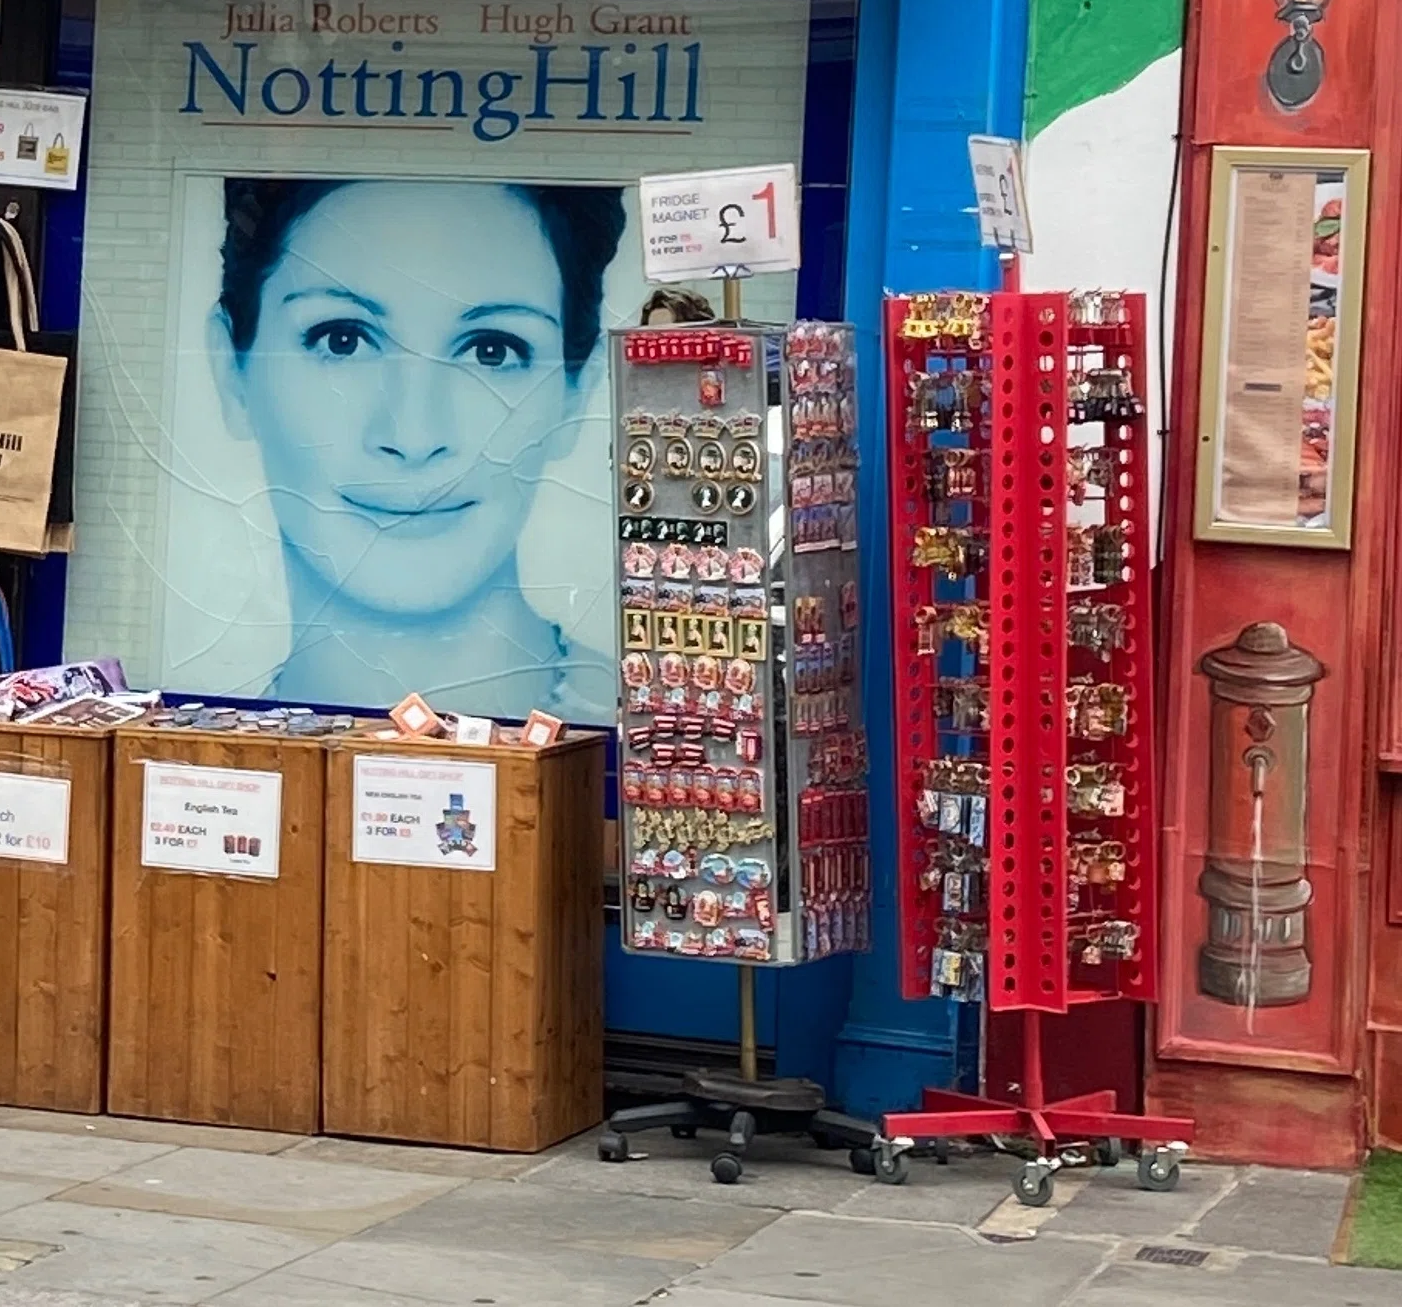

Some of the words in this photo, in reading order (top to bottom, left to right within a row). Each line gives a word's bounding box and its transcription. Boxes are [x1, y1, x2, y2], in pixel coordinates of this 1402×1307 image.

[221, 2, 295, 39] Julia
[311, 2, 439, 35] Roberts
[480, 4, 575, 42] Hugh
[590, 5, 693, 37] Grant
[651, 193, 700, 208] FRIDGE
[652, 208, 709, 224] MAGNET
[184, 802, 219, 814] English
[222, 805, 238, 815] Tea
[390, 813, 420, 824] EACH
[178, 824, 207, 836] EACH
[366, 826, 372, 835] 3
[375, 826, 397, 836] FOR
[5, 833, 23, 847] for
[26, 835, 51, 850] £10
[155, 836, 160, 845] 3
[163, 837, 184, 847] FOR
